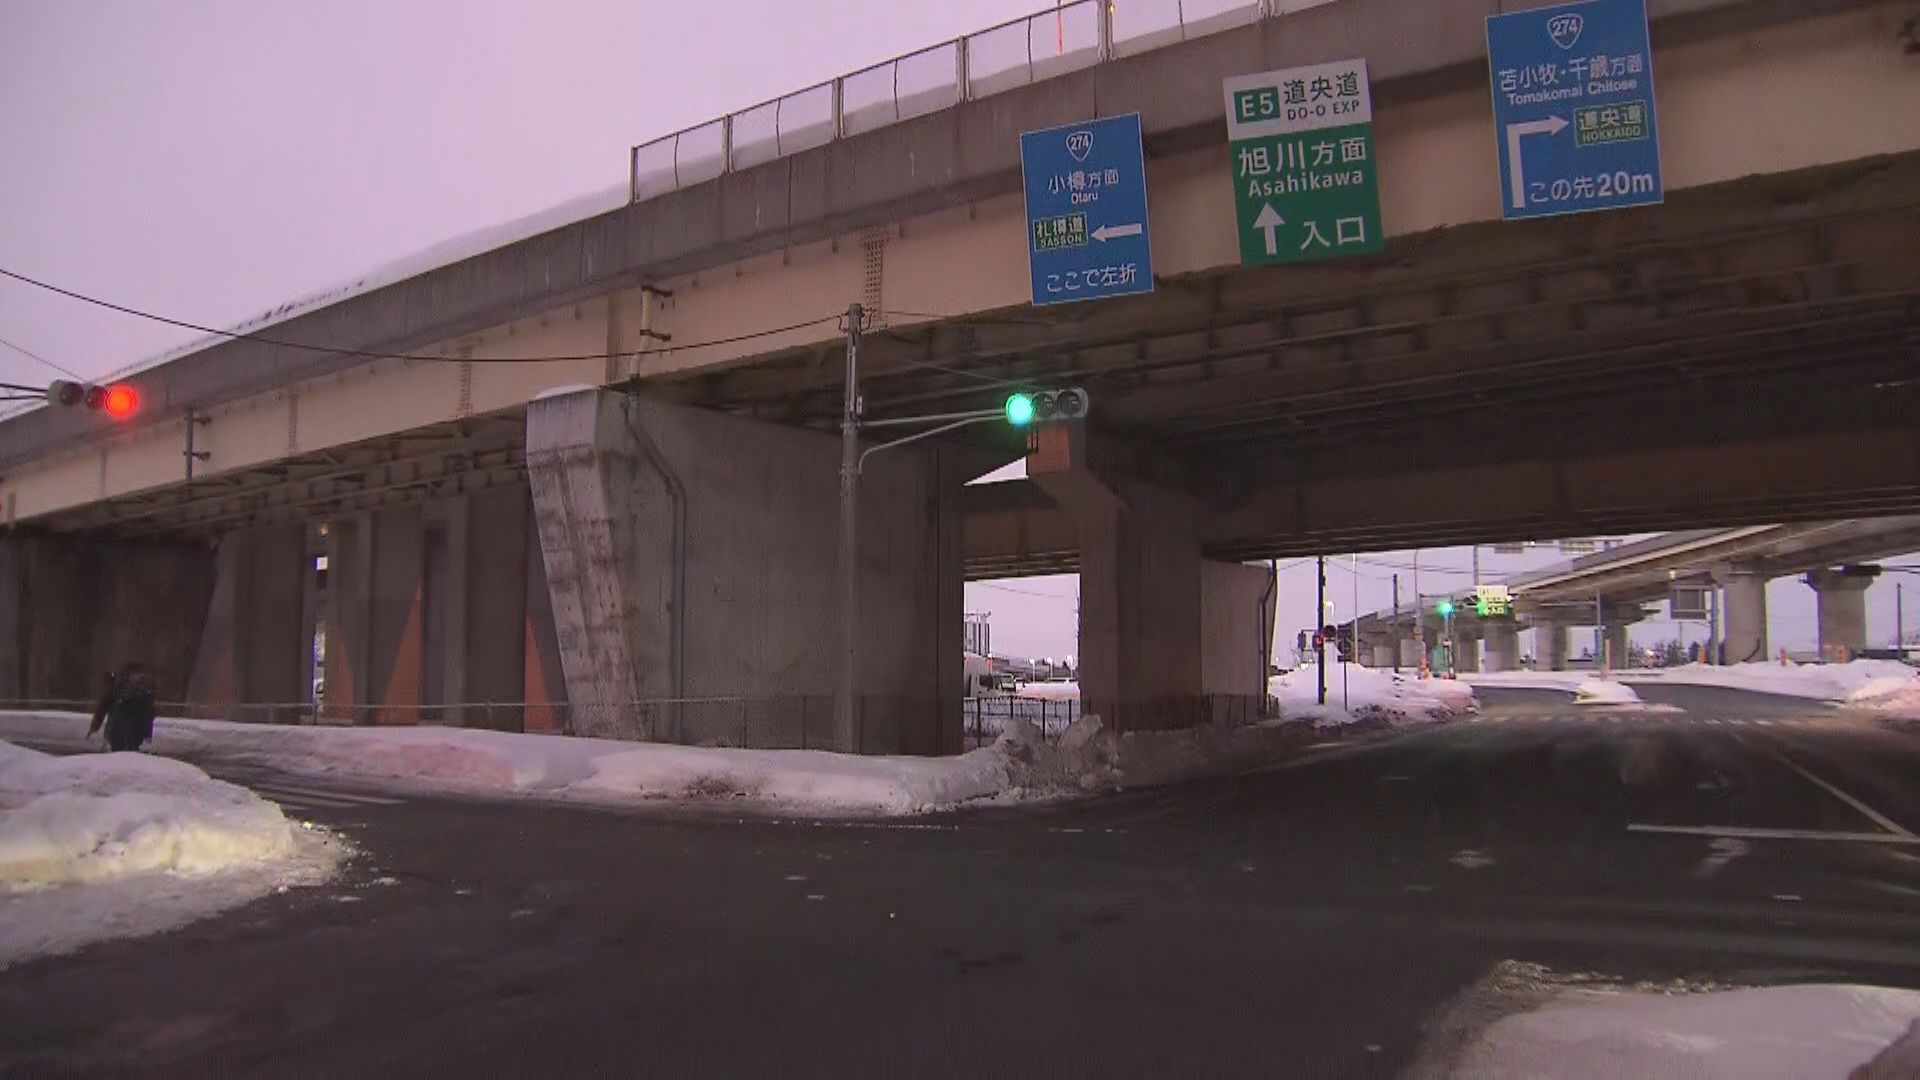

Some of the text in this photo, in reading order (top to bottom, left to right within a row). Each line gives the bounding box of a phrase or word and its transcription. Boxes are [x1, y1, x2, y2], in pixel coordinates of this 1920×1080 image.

[1552, 19, 1578, 37] 274
[1283, 71, 1360, 105] 道央道
[1507, 78, 1638, 106] Tomakomai Chitose
[1241, 92, 1274, 118] E5
[1287, 99, 1360, 121] DO-O EXP
[1579, 106, 1642, 132] 道央道
[1070, 135, 1089, 151] 274
[1582, 126, 1641, 143] HOKKAIDO
[1238, 137, 1366, 178] 旭川方面
[1048, 168, 1119, 195] 小樽方面
[1248, 168, 1363, 198] Asahikawa
[1530, 170, 1654, 203] この先20m
[1070, 192, 1099, 205] Otaru
[1040, 233, 1082, 249] SASSON
[1299, 216, 1366, 250] 入口
[1047, 263, 1137, 293] ここで左折
